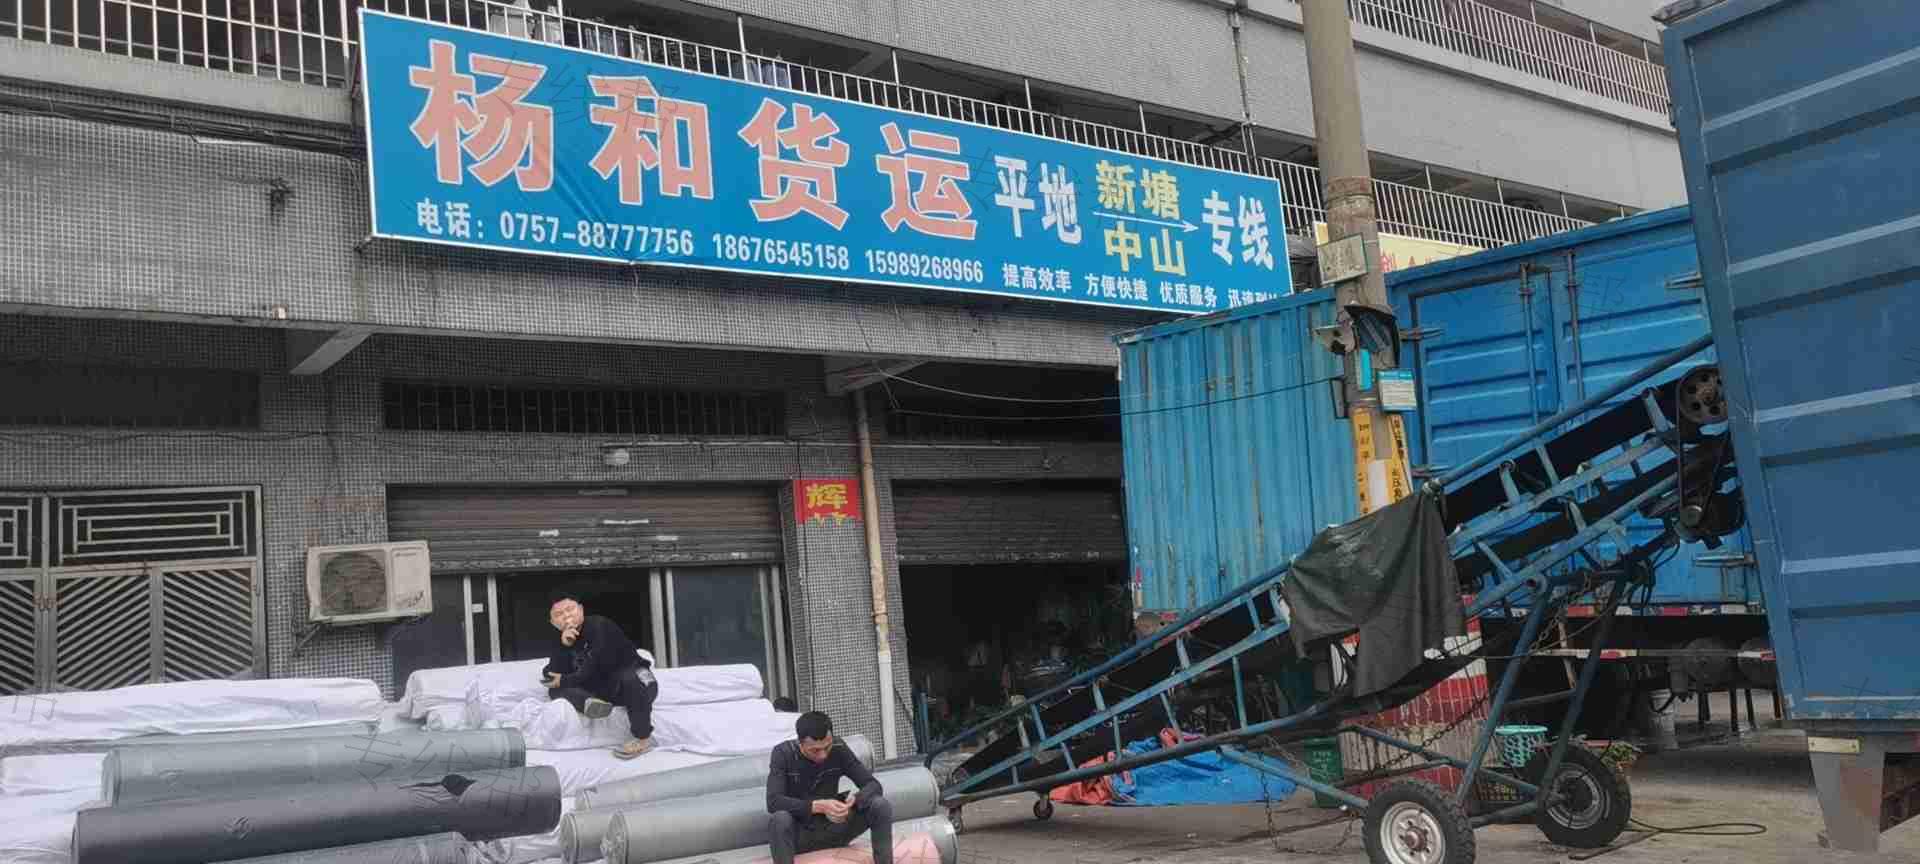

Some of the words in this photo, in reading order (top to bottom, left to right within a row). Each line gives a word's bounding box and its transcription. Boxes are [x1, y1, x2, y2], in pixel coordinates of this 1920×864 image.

[409, 39, 977, 241] 杨和货运
[994, 155, 1083, 245] 平地
[1201, 190, 1275, 272] 专线
[1094, 159, 1182, 220] 新塘
[499, 210, 695, 257] 0757-88777756
[711, 232, 851, 271] 18676545158
[864, 249, 985, 284] 15989268966
[1001, 262, 1073, 293] 提高效率
[1084, 273, 1149, 302] 方便快捷
[1158, 281, 1219, 310] 优质服务
[1103, 221, 1187, 277] 中山
